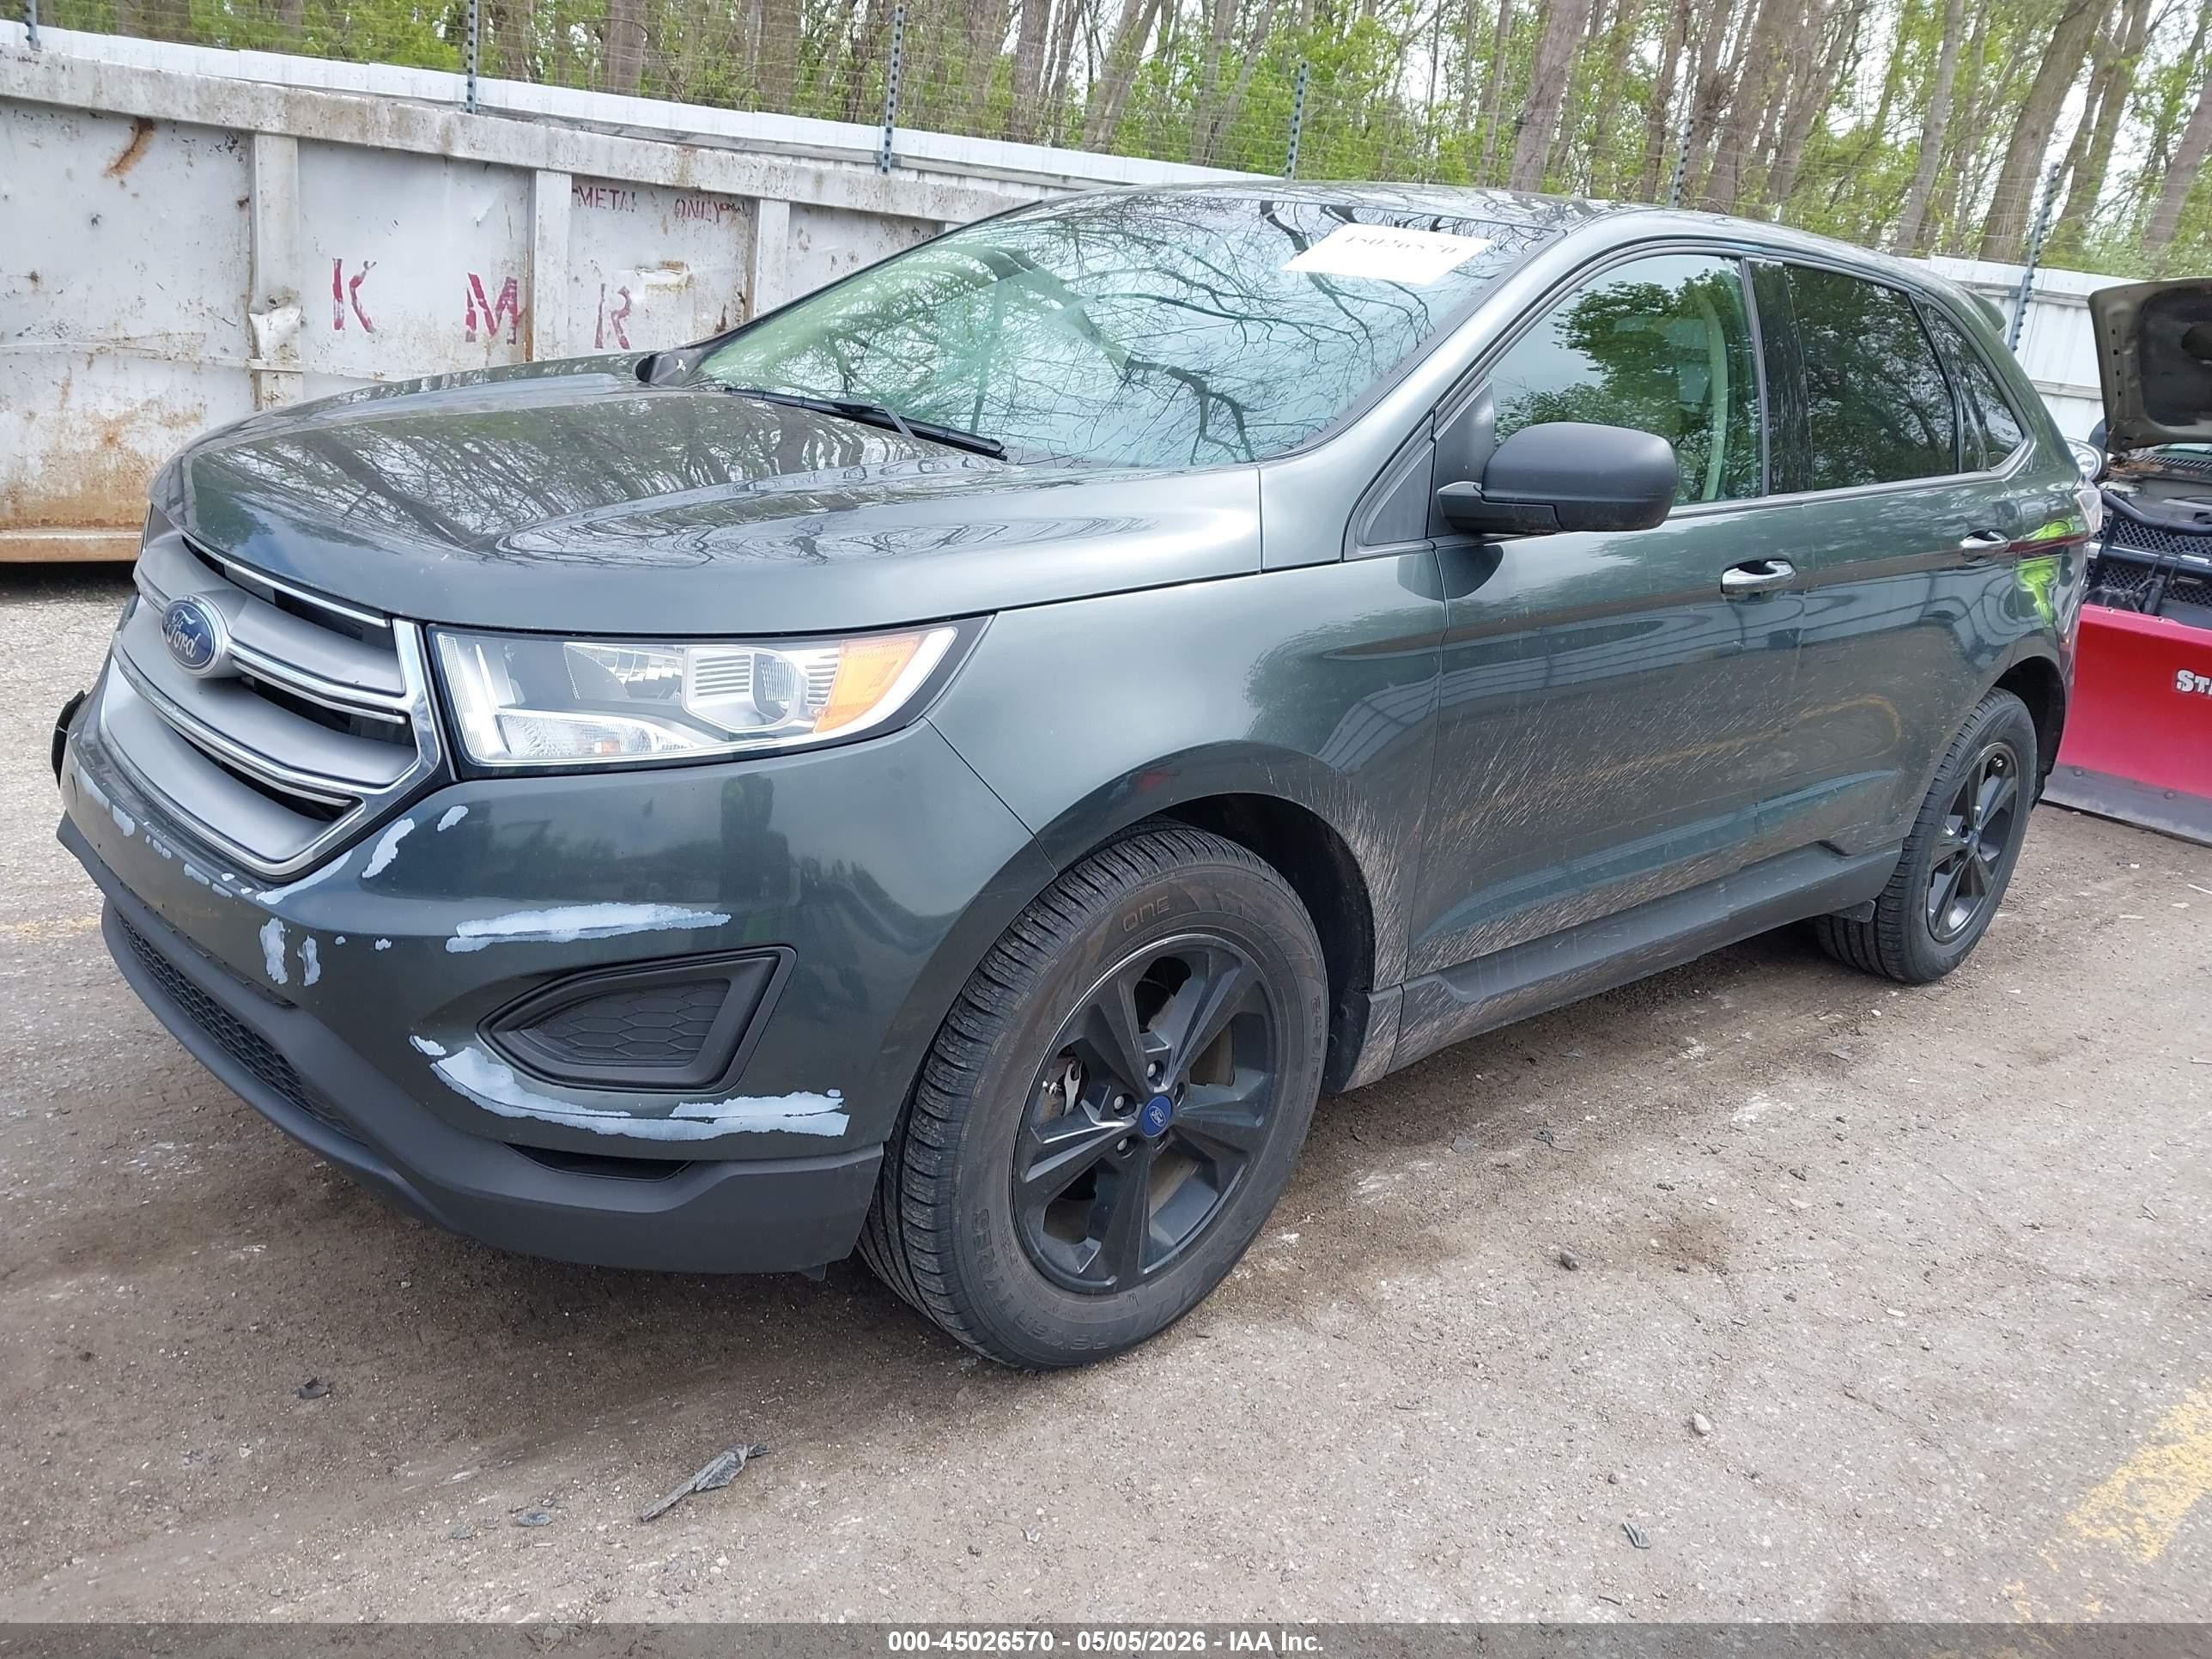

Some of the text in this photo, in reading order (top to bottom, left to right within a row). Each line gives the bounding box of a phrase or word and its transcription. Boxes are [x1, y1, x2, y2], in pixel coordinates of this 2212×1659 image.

[332, 258, 633, 349] K M R
[166, 609, 202, 659] Ford
